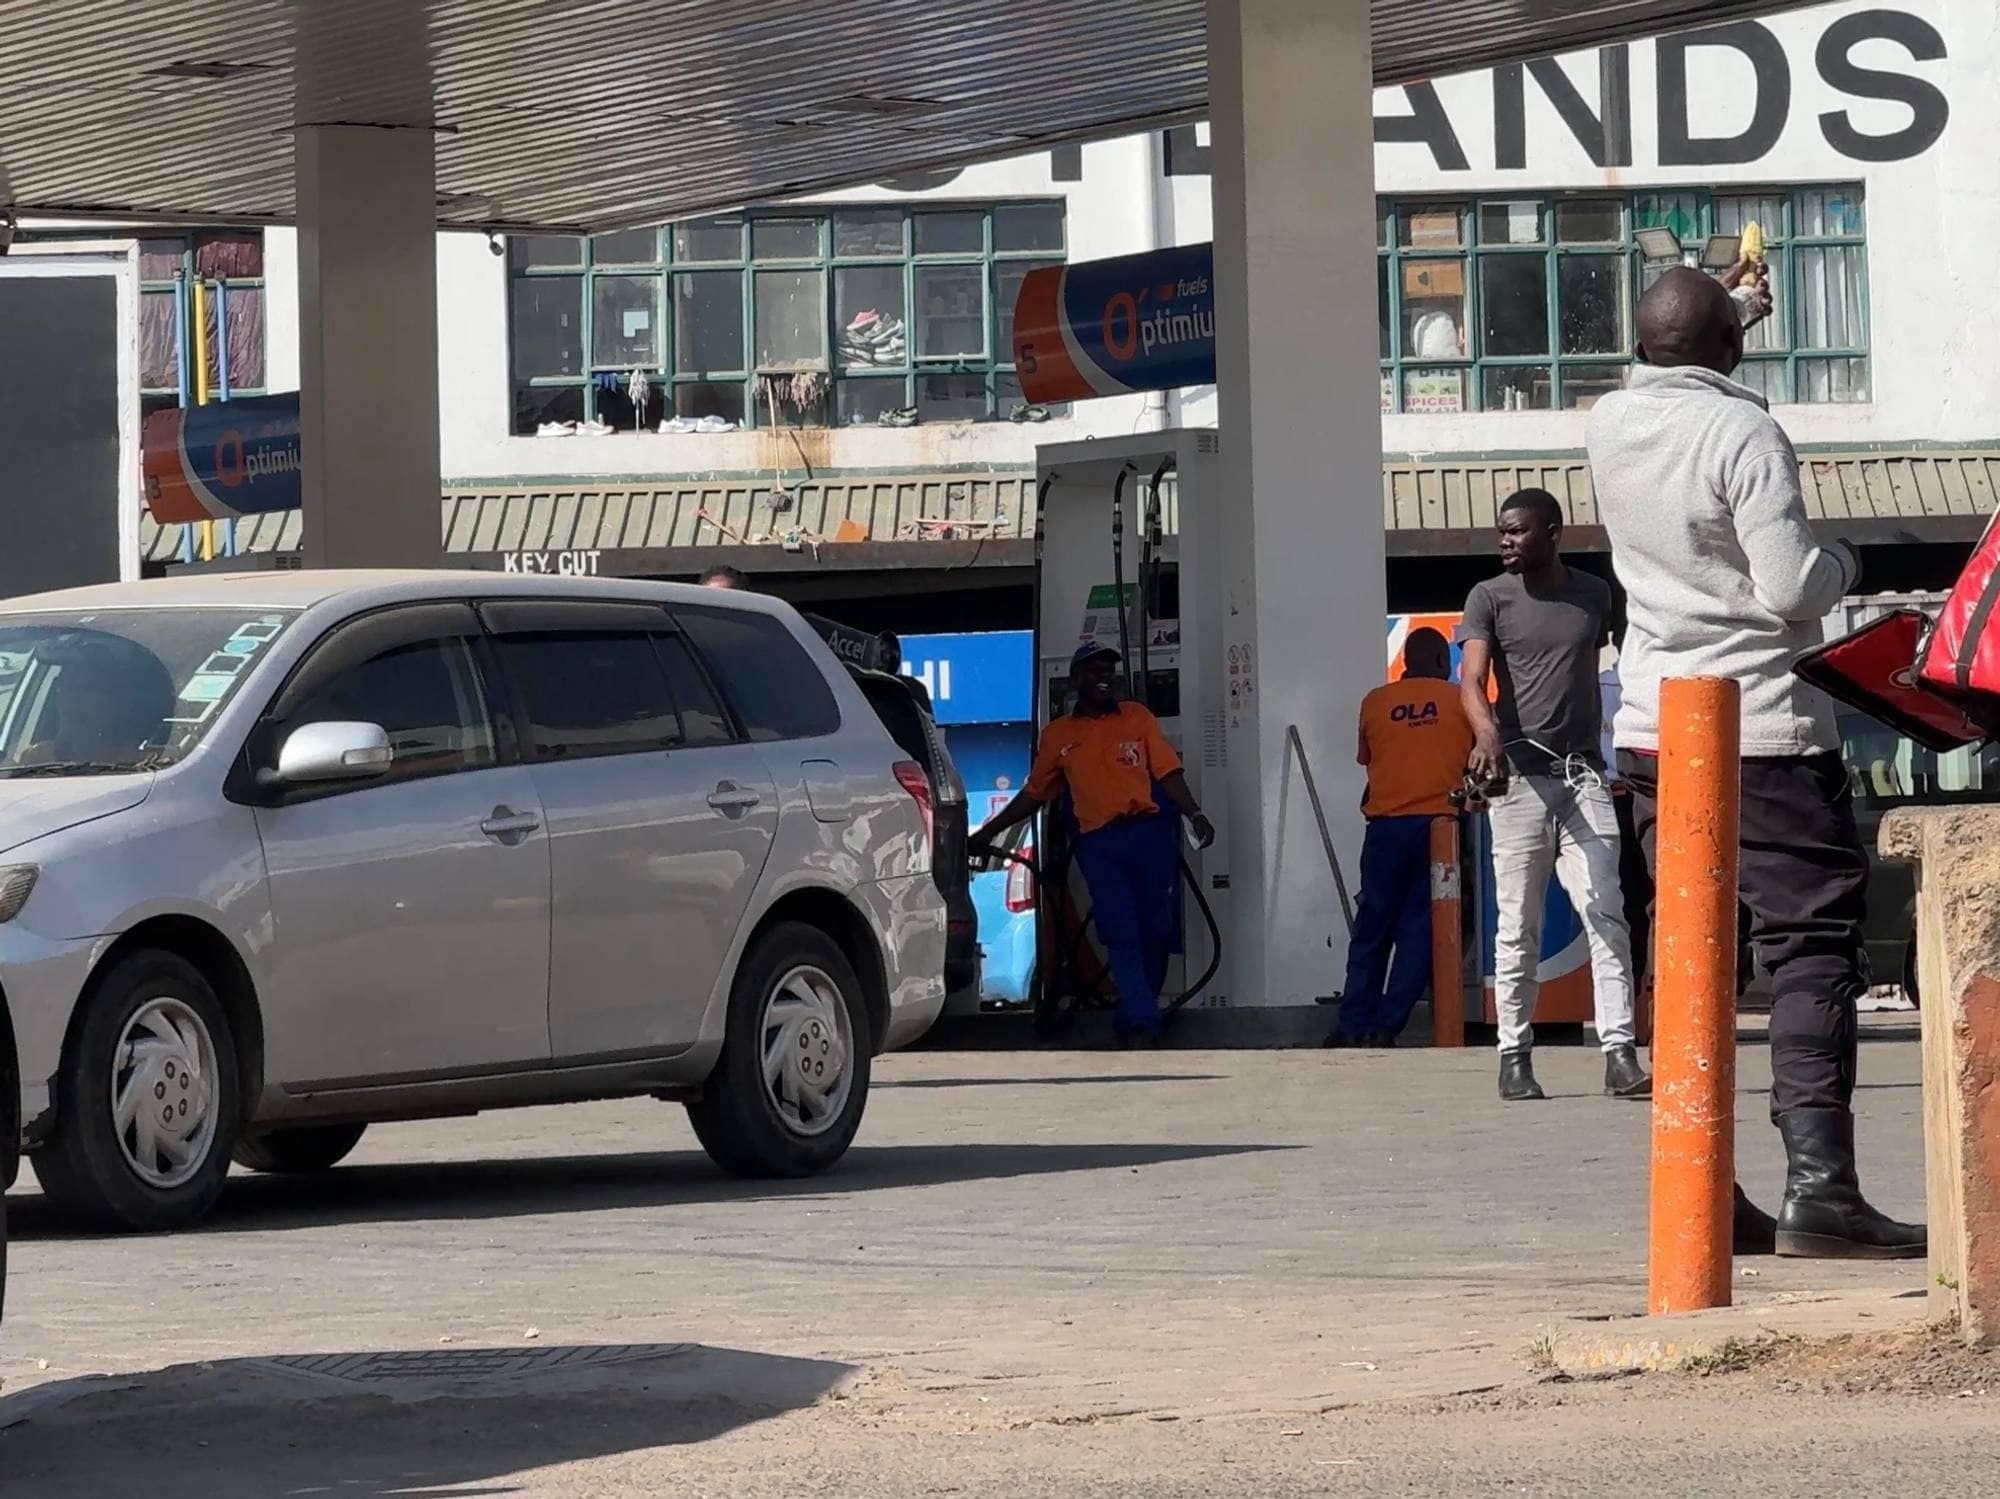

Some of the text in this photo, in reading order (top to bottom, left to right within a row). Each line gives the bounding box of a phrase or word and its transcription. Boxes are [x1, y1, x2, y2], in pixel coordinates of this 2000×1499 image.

[1176, 276, 1208, 297] fuels
[1019, 343, 1038, 374] 5
[559, 550, 601, 576] CUT
[827, 629, 867, 660] Accel
[1391, 702, 1437, 721] OLA
